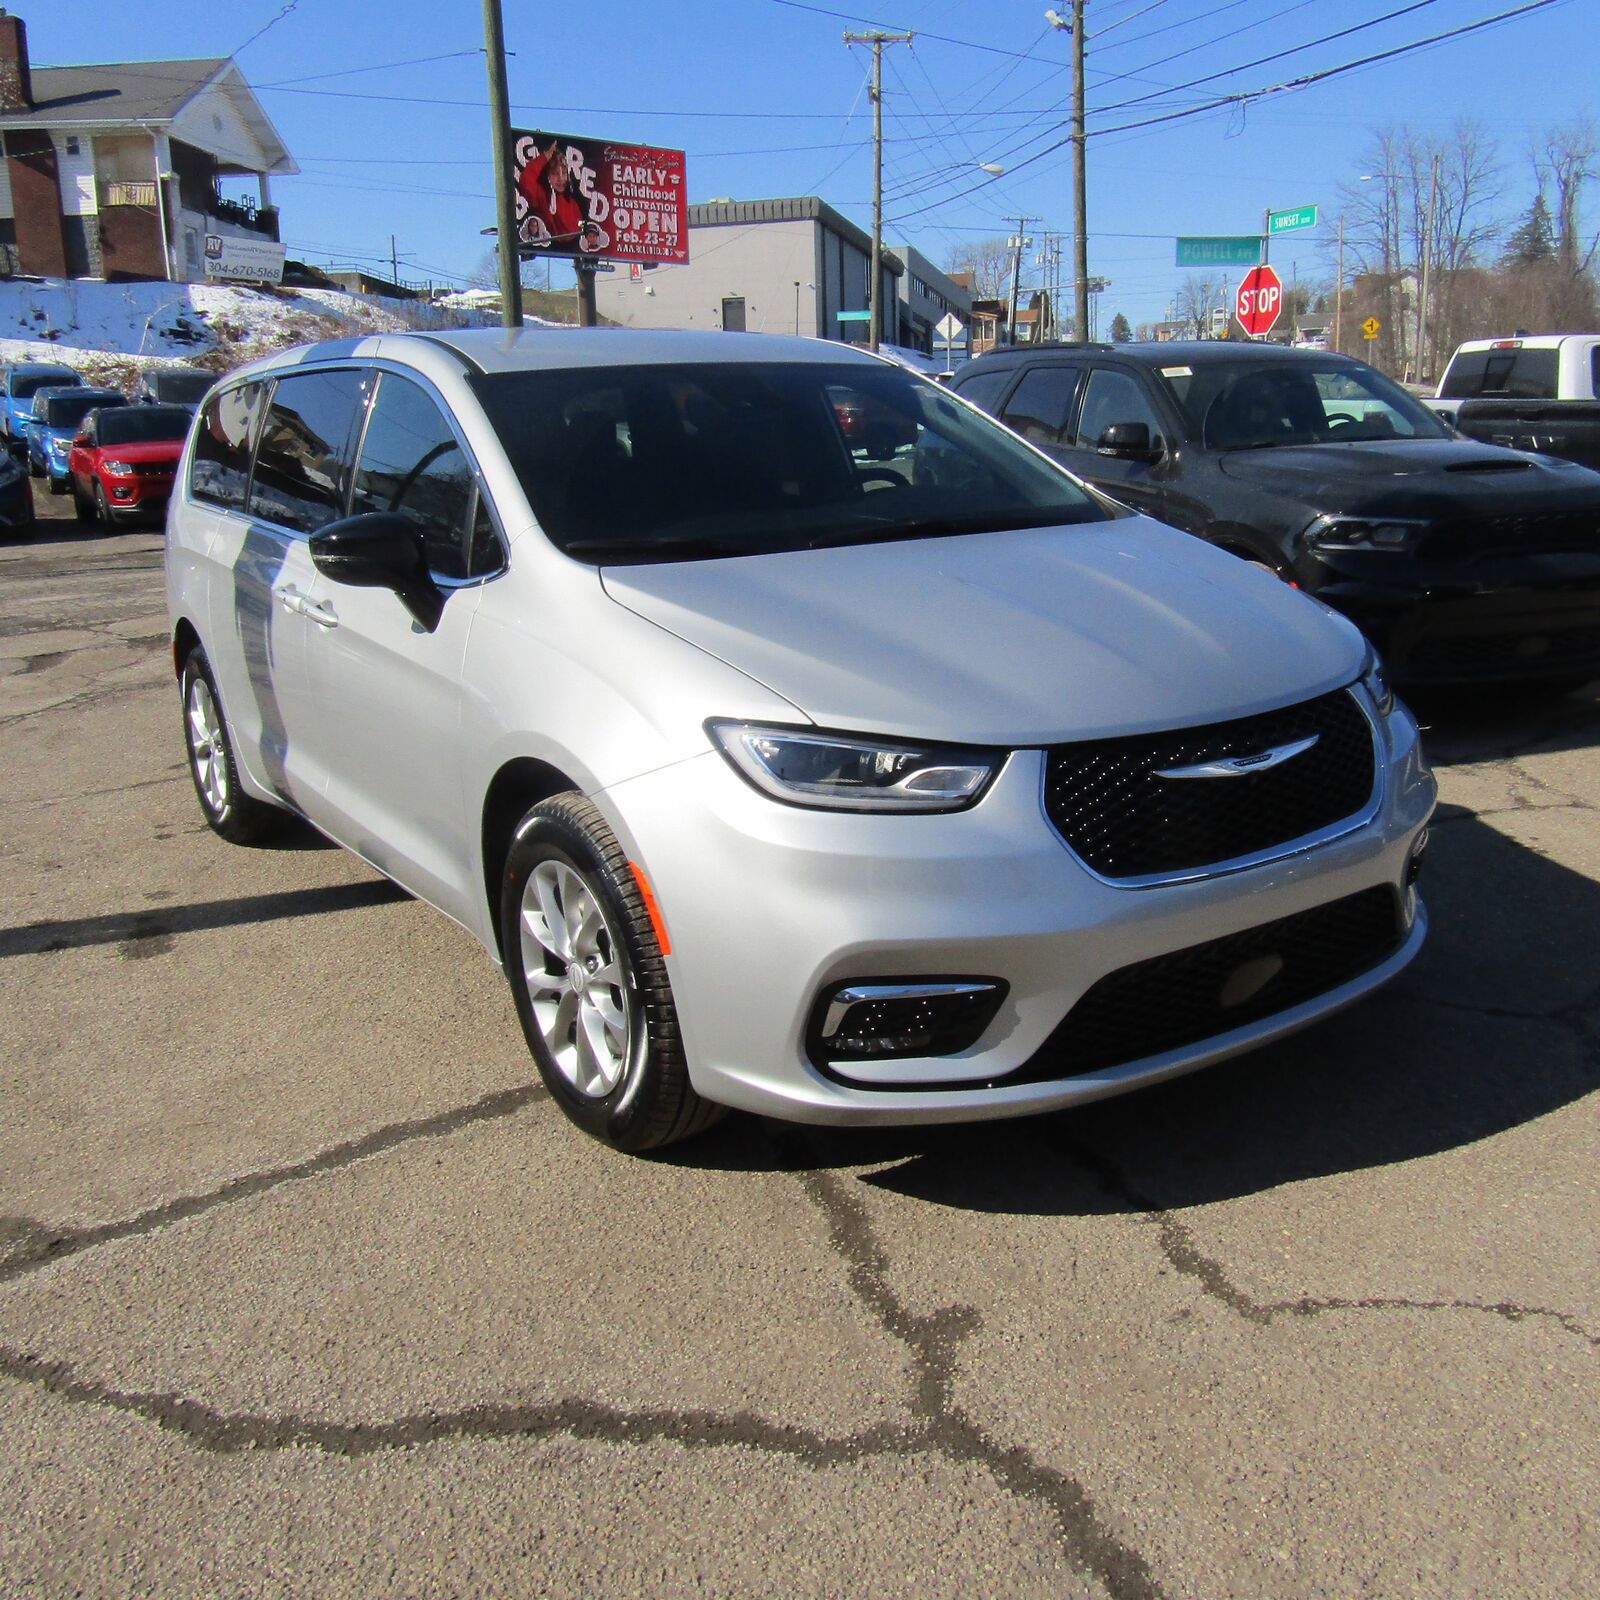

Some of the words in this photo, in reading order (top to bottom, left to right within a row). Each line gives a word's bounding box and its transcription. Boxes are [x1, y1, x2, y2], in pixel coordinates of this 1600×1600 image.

[613, 164, 667, 186] EARLY
[613, 183, 676, 201] Childhood
[613, 198, 677, 212] REGISTRATION
[613, 208, 678, 233] OPEN
[1274, 213, 1300, 229] SUNSET
[207, 237, 221, 250] RV
[616, 230, 643, 243] Feb.
[644, 232, 678, 246] 23-27
[1184, 243, 1232, 259] POWELL
[208, 261, 280, 278] 304-670-5168
[1239, 286, 1279, 316] STOP
